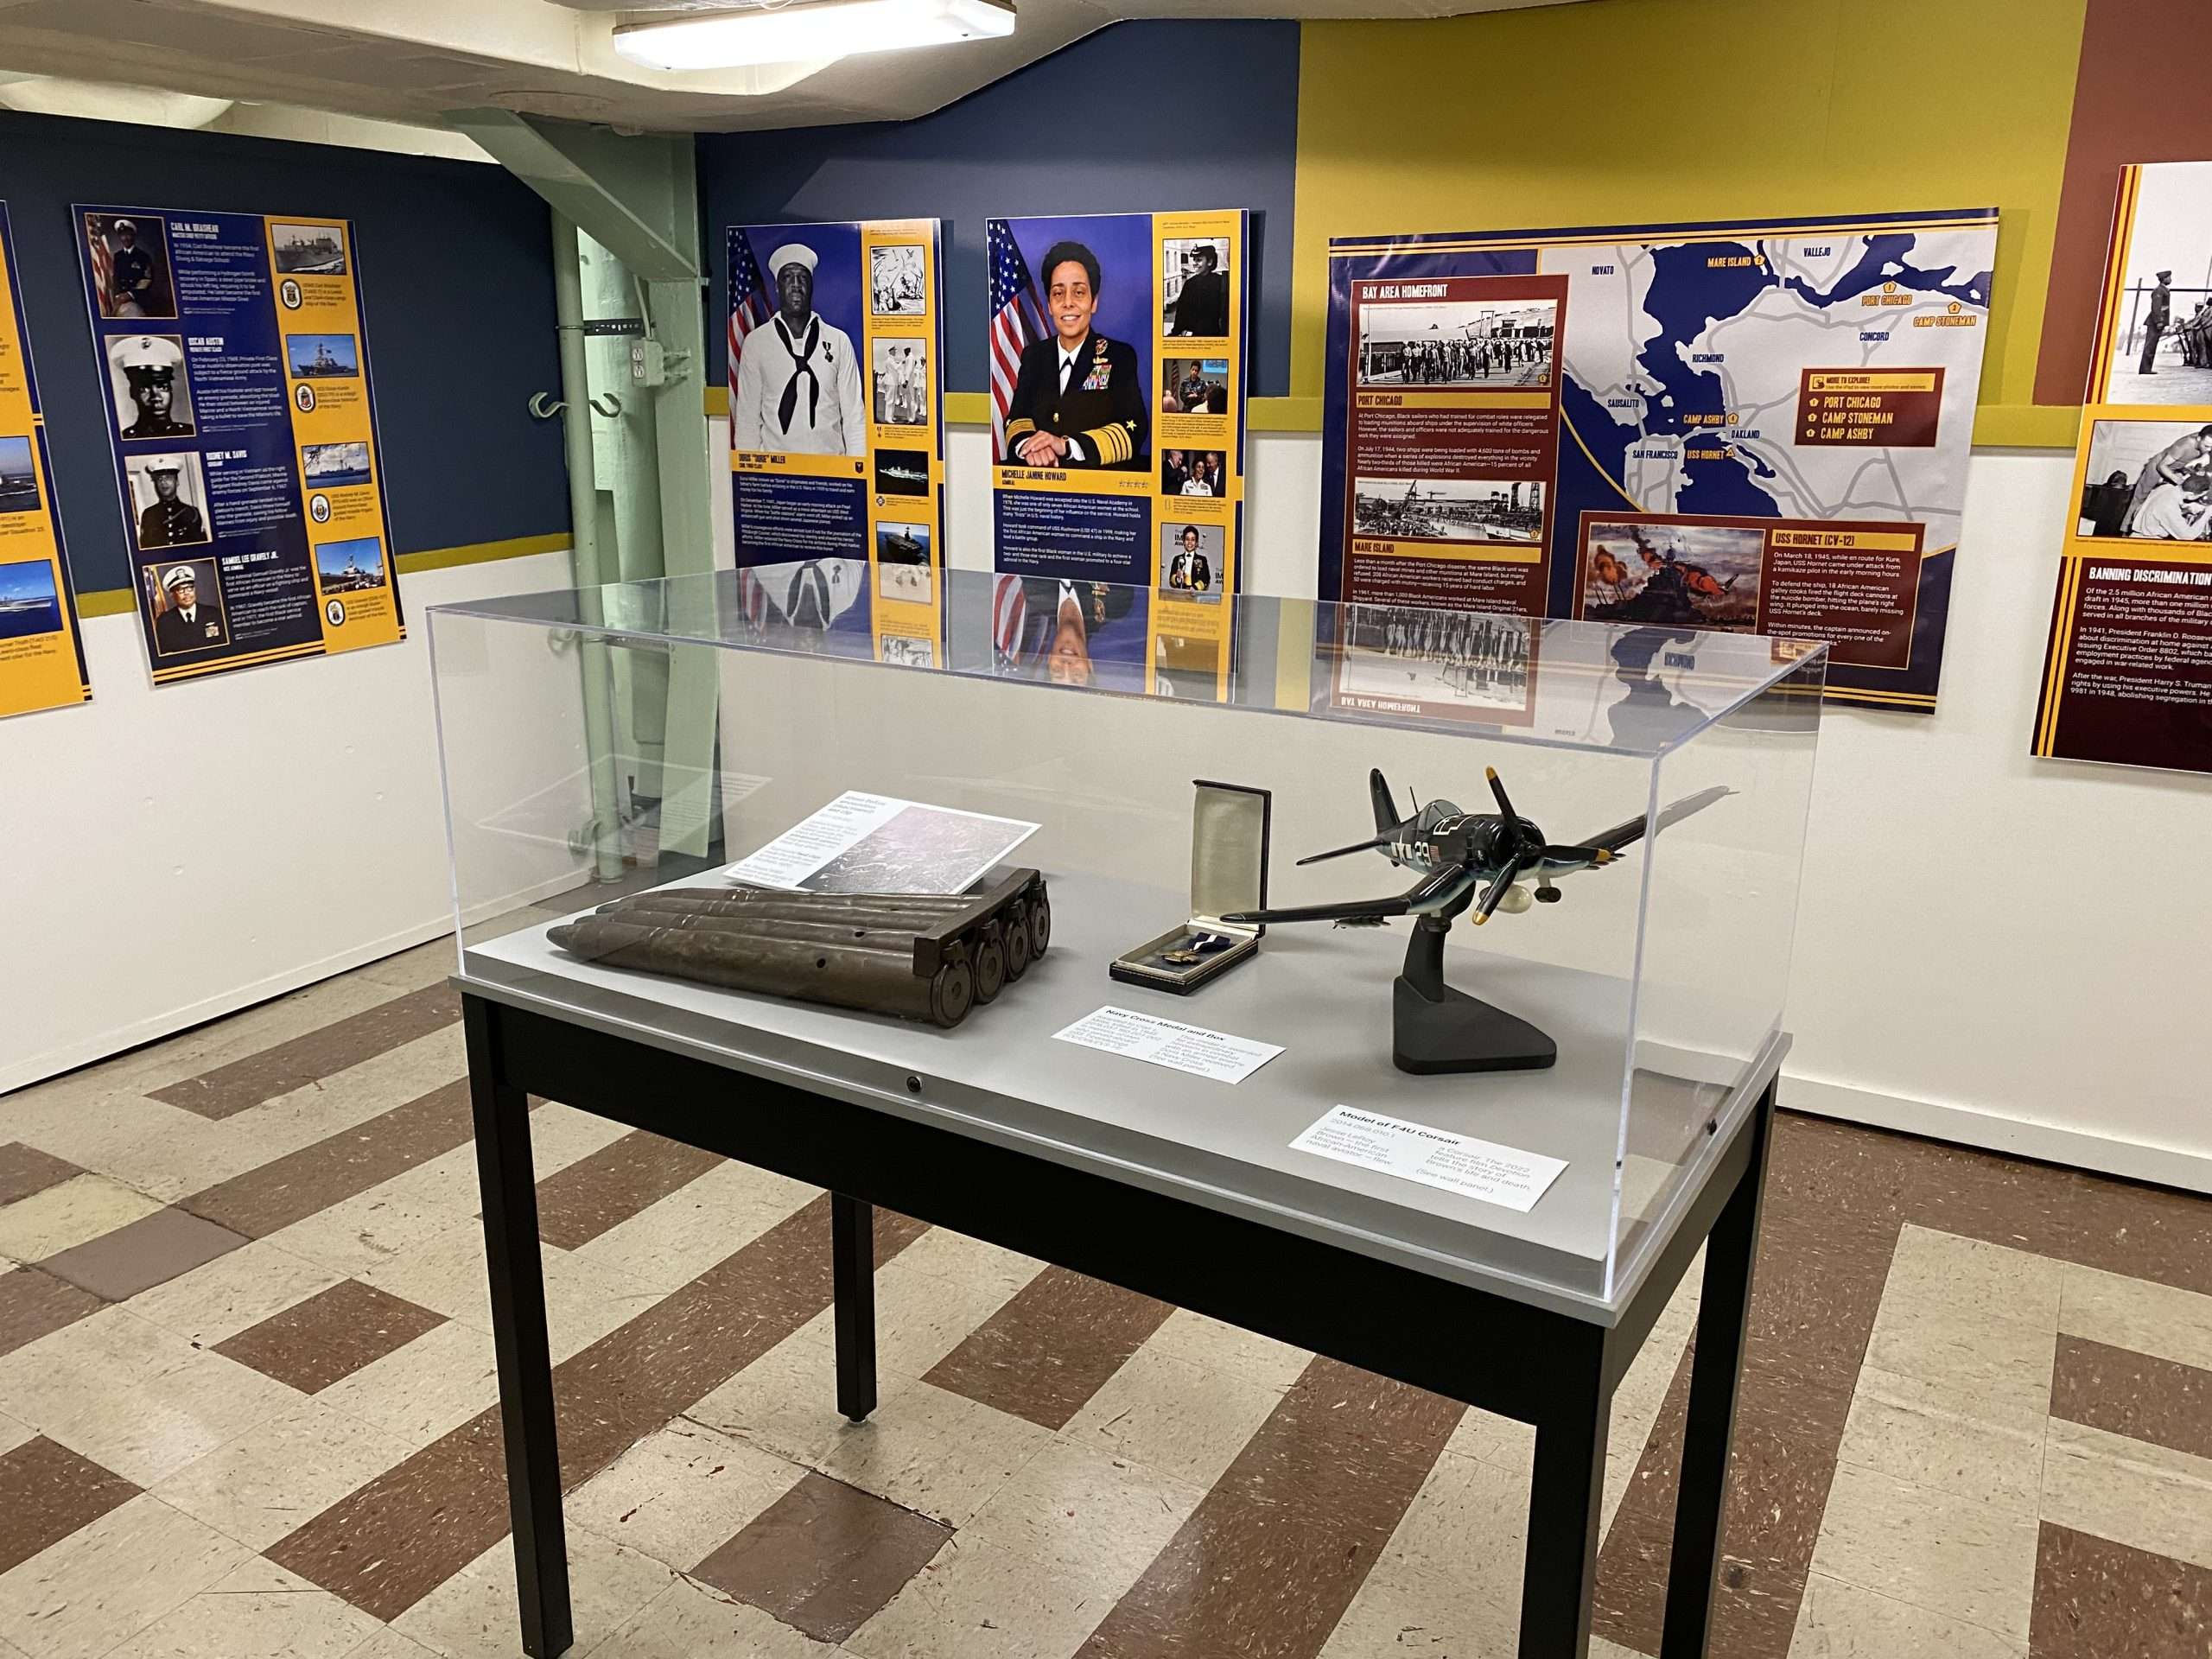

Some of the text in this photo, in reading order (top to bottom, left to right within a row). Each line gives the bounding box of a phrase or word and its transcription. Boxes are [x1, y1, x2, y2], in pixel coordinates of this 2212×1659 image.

[1804, 247, 1830, 257] VALLEJO
[1707, 256, 1751, 268] MARE ISLAND
[1592, 266, 1614, 275] NOVATO
[1362, 283, 1448, 300] BAY AREA HOMEFRONT
[1861, 294, 1912, 306] PORT CHICAGO
[1913, 315, 1977, 327] CAMP STONEMAN
[1859, 332, 1889, 342] CONCORD
[1692, 354, 1724, 363] RICHMOND
[1358, 396, 1402, 406] PORT CHICAGO
[1608, 399, 1639, 408] SAUSALITO
[1823, 397, 1881, 409] PORT CHICAGO
[1683, 415, 1725, 424] CAMP ASHBY
[1822, 412, 1894, 424] CAMP STONEMAN
[1732, 430, 1760, 439] OAKLAND
[1821, 428, 1874, 440] CAMP ASHBY
[771, 455, 785, 464] MILLER
[1633, 450, 1678, 460] SAN FRANCISCO
[1687, 450, 1724, 460] USS HORNET
[1002, 469, 1066, 480] MICHELLE JANINE HOWARD
[1775, 532, 1790, 544] USS
[1793, 533, 1822, 545] HORNET
[1355, 542, 1395, 554] MARE ISLAND
[222, 555, 241, 565] SAMUEL
[251, 552, 270, 563] GRAVELY
[2088, 567, 2212, 586] BANNING DISCRIMINATION
[2112, 596, 2130, 605] 1945,
[2108, 605, 2129, 613] Along
[2147, 607, 2184, 615] thousands
[2154, 678, 2173, 687] Harry
[2118, 690, 2154, 701] abolishing
[2155, 695, 2196, 704] segregation
[1415, 842, 1432, 867] 29
[1106, 1009, 1128, 1018] Navy
[1130, 1015, 1155, 1024] Cross
[1157, 1021, 1186, 1031] Medal
[1339, 1111, 1376, 1123] Model
[1391, 1124, 1416, 1134] F4U
[1418, 1131, 1460, 1146] Corsair
